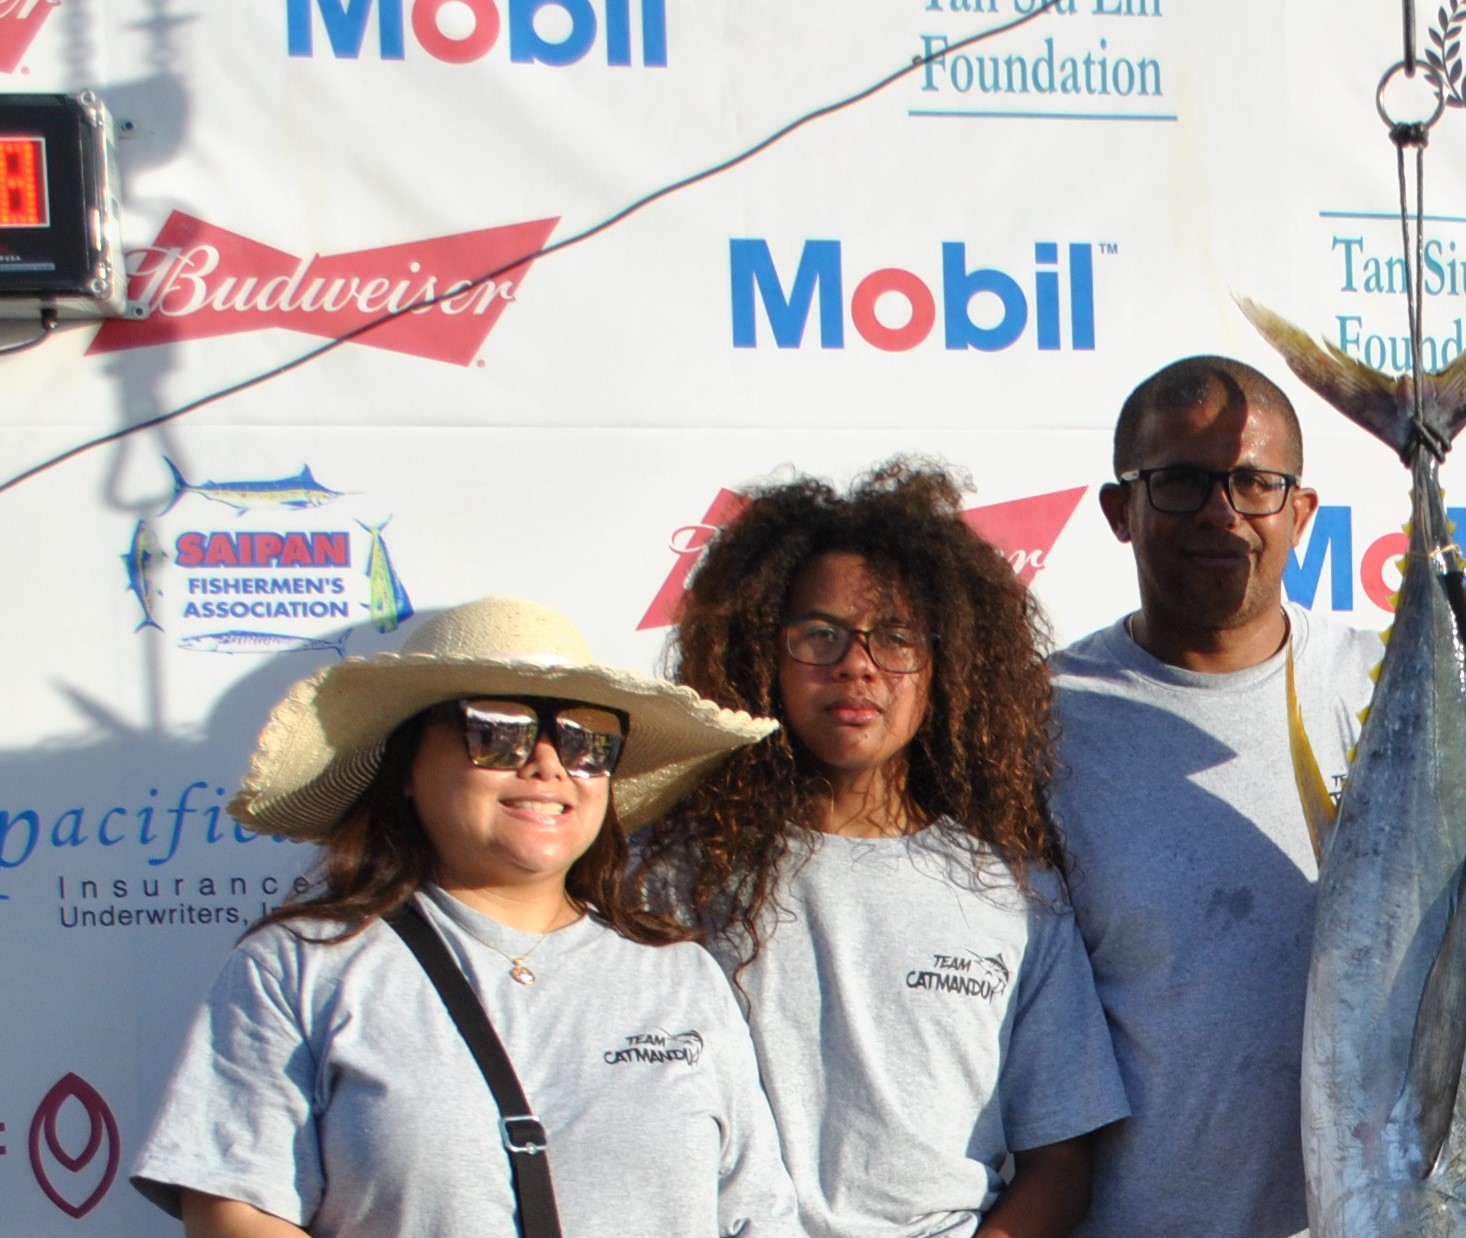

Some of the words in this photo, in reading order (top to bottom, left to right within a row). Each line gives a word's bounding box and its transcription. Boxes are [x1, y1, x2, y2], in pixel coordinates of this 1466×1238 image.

[920, 34, 1164, 97] Foundation
[1332, 235, 1409, 294] Tan
[126, 244, 517, 318] Budweiser
[729, 237, 1096, 352] Mobil
[174, 531, 351, 568] SAIPAN
[188, 577, 345, 594] FISHERMEN'S
[183, 600, 350, 619] ASSOCIATION
[0, 780, 288, 900] pacifi
[59, 875, 310, 900] Insurance
[59, 904, 249, 928] Underwriters,
[933, 954, 972, 972] TEAM
[905, 970, 991, 999] CATMANDU
[625, 1033, 666, 1048] TEAM
